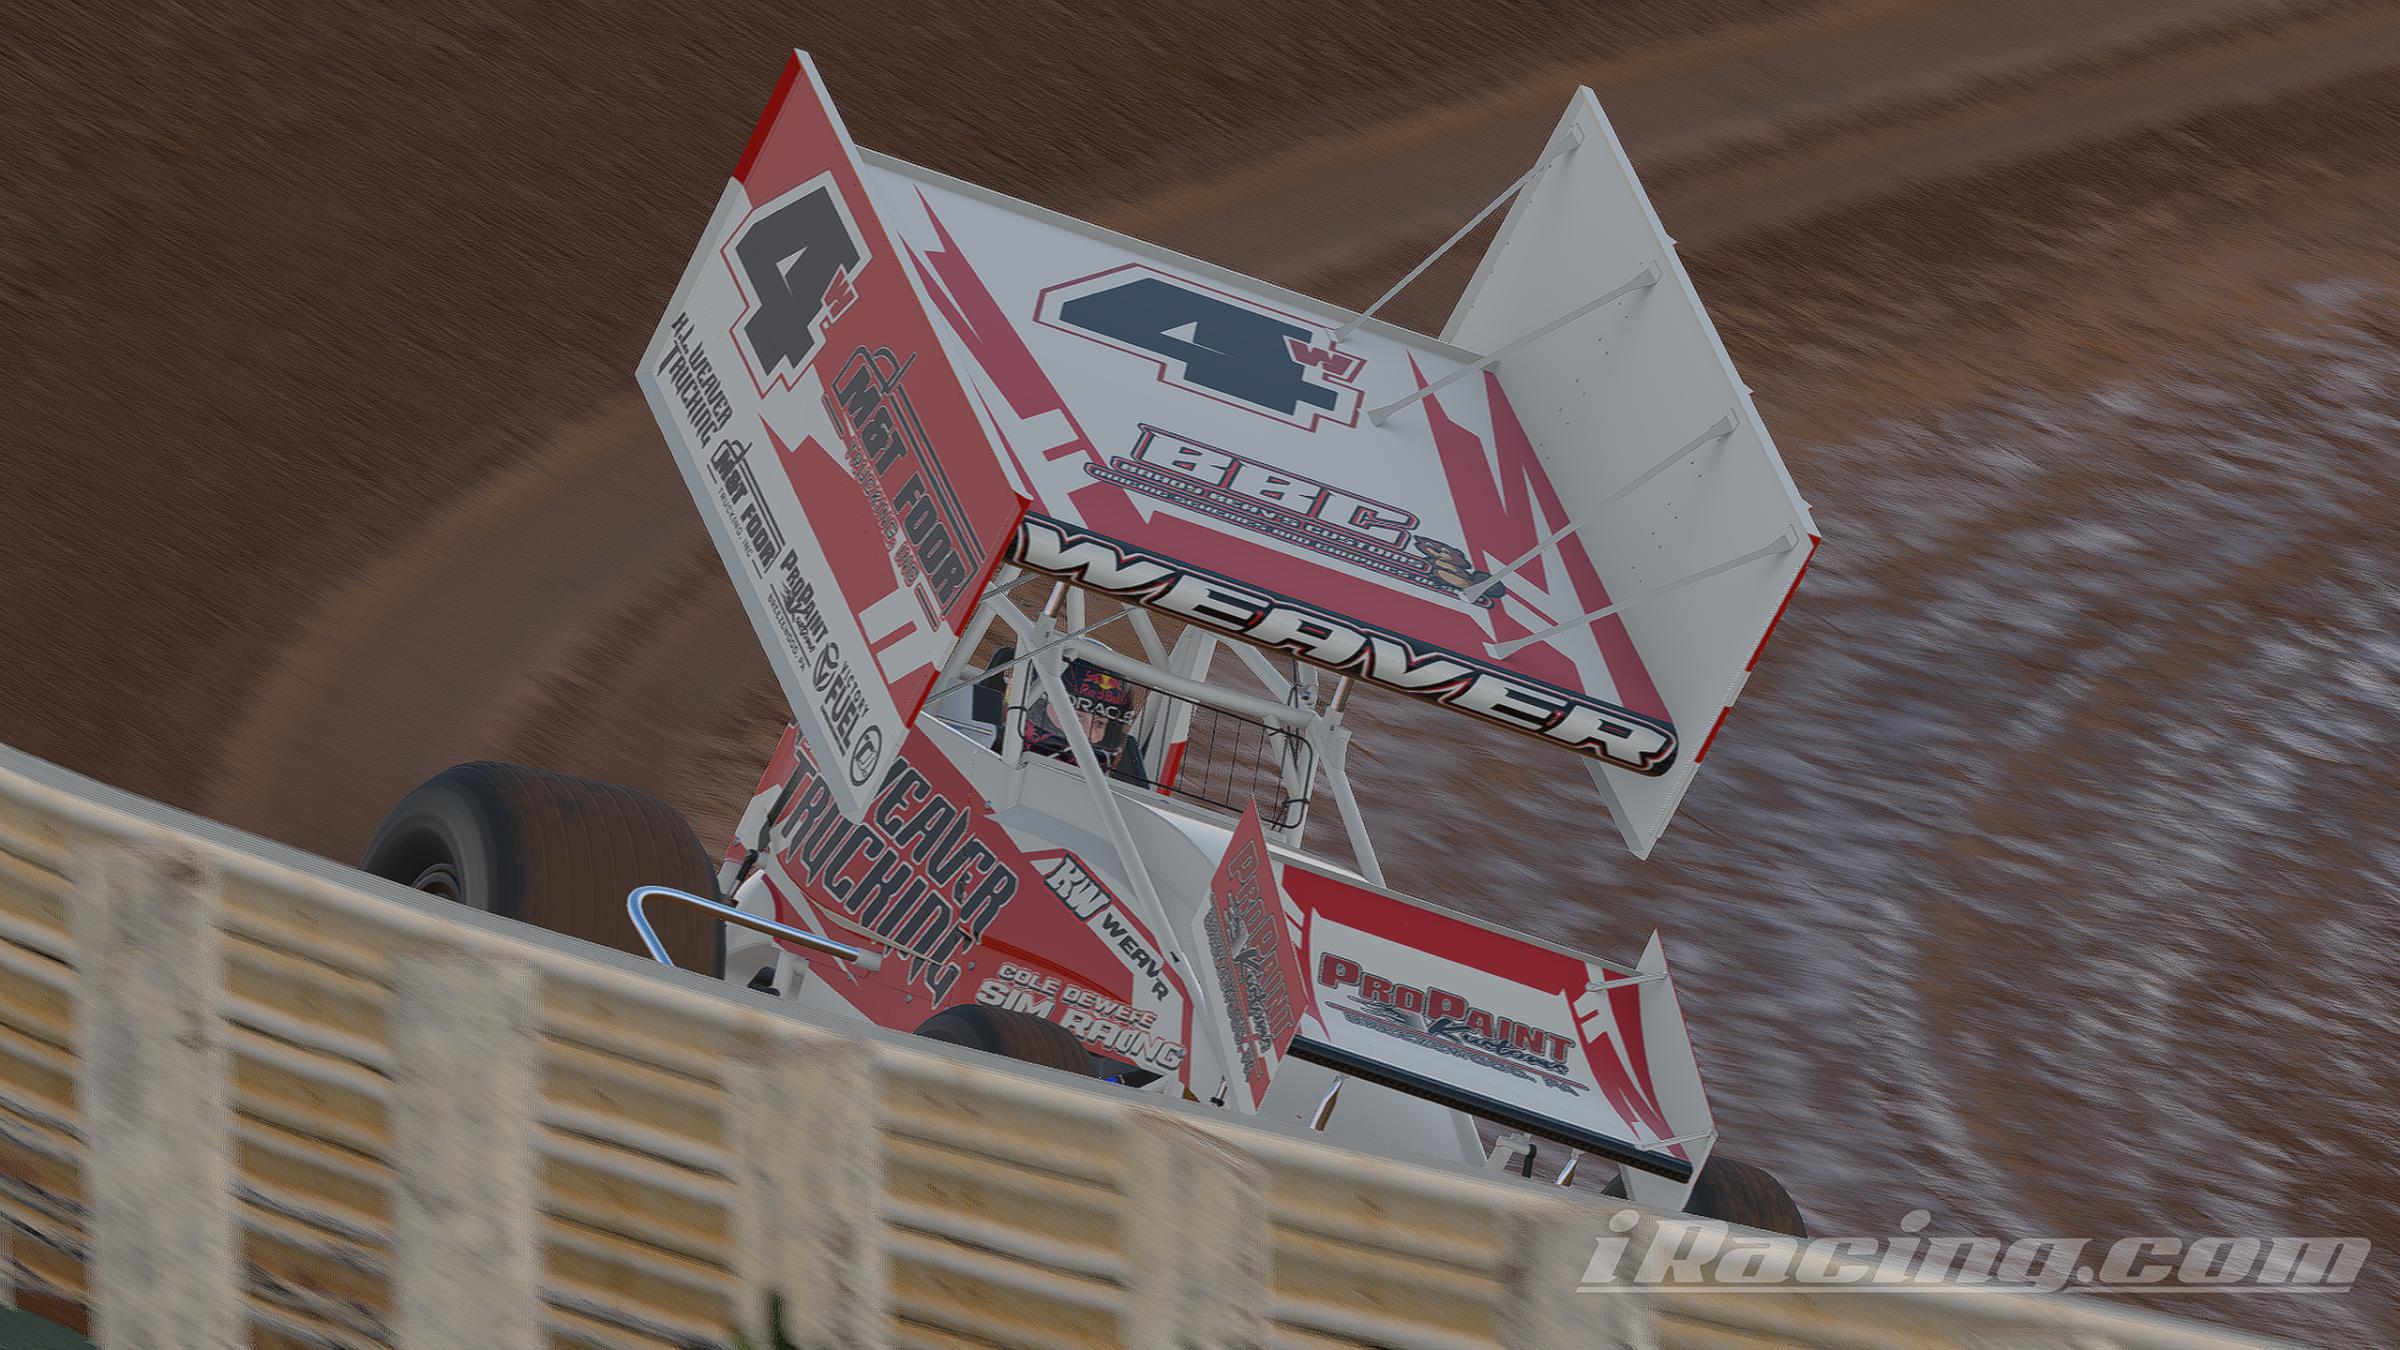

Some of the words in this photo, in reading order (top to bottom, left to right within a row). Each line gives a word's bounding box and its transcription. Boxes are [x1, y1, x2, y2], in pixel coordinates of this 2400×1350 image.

[656, 339, 719, 450] TRUCKING
[688, 341, 733, 431] WEAVER
[838, 364, 908, 477] M&T
[1132, 423, 1420, 550] BBC
[841, 660, 870, 718] VICTORY
[1018, 518, 1674, 768] WEAVER
[824, 672, 860, 750] FUEL
[768, 748, 975, 1010] TRUCKING
[975, 979, 1055, 1020] SIM
[1058, 1006, 1187, 1071] RACING
[997, 962, 1061, 995] COLE
